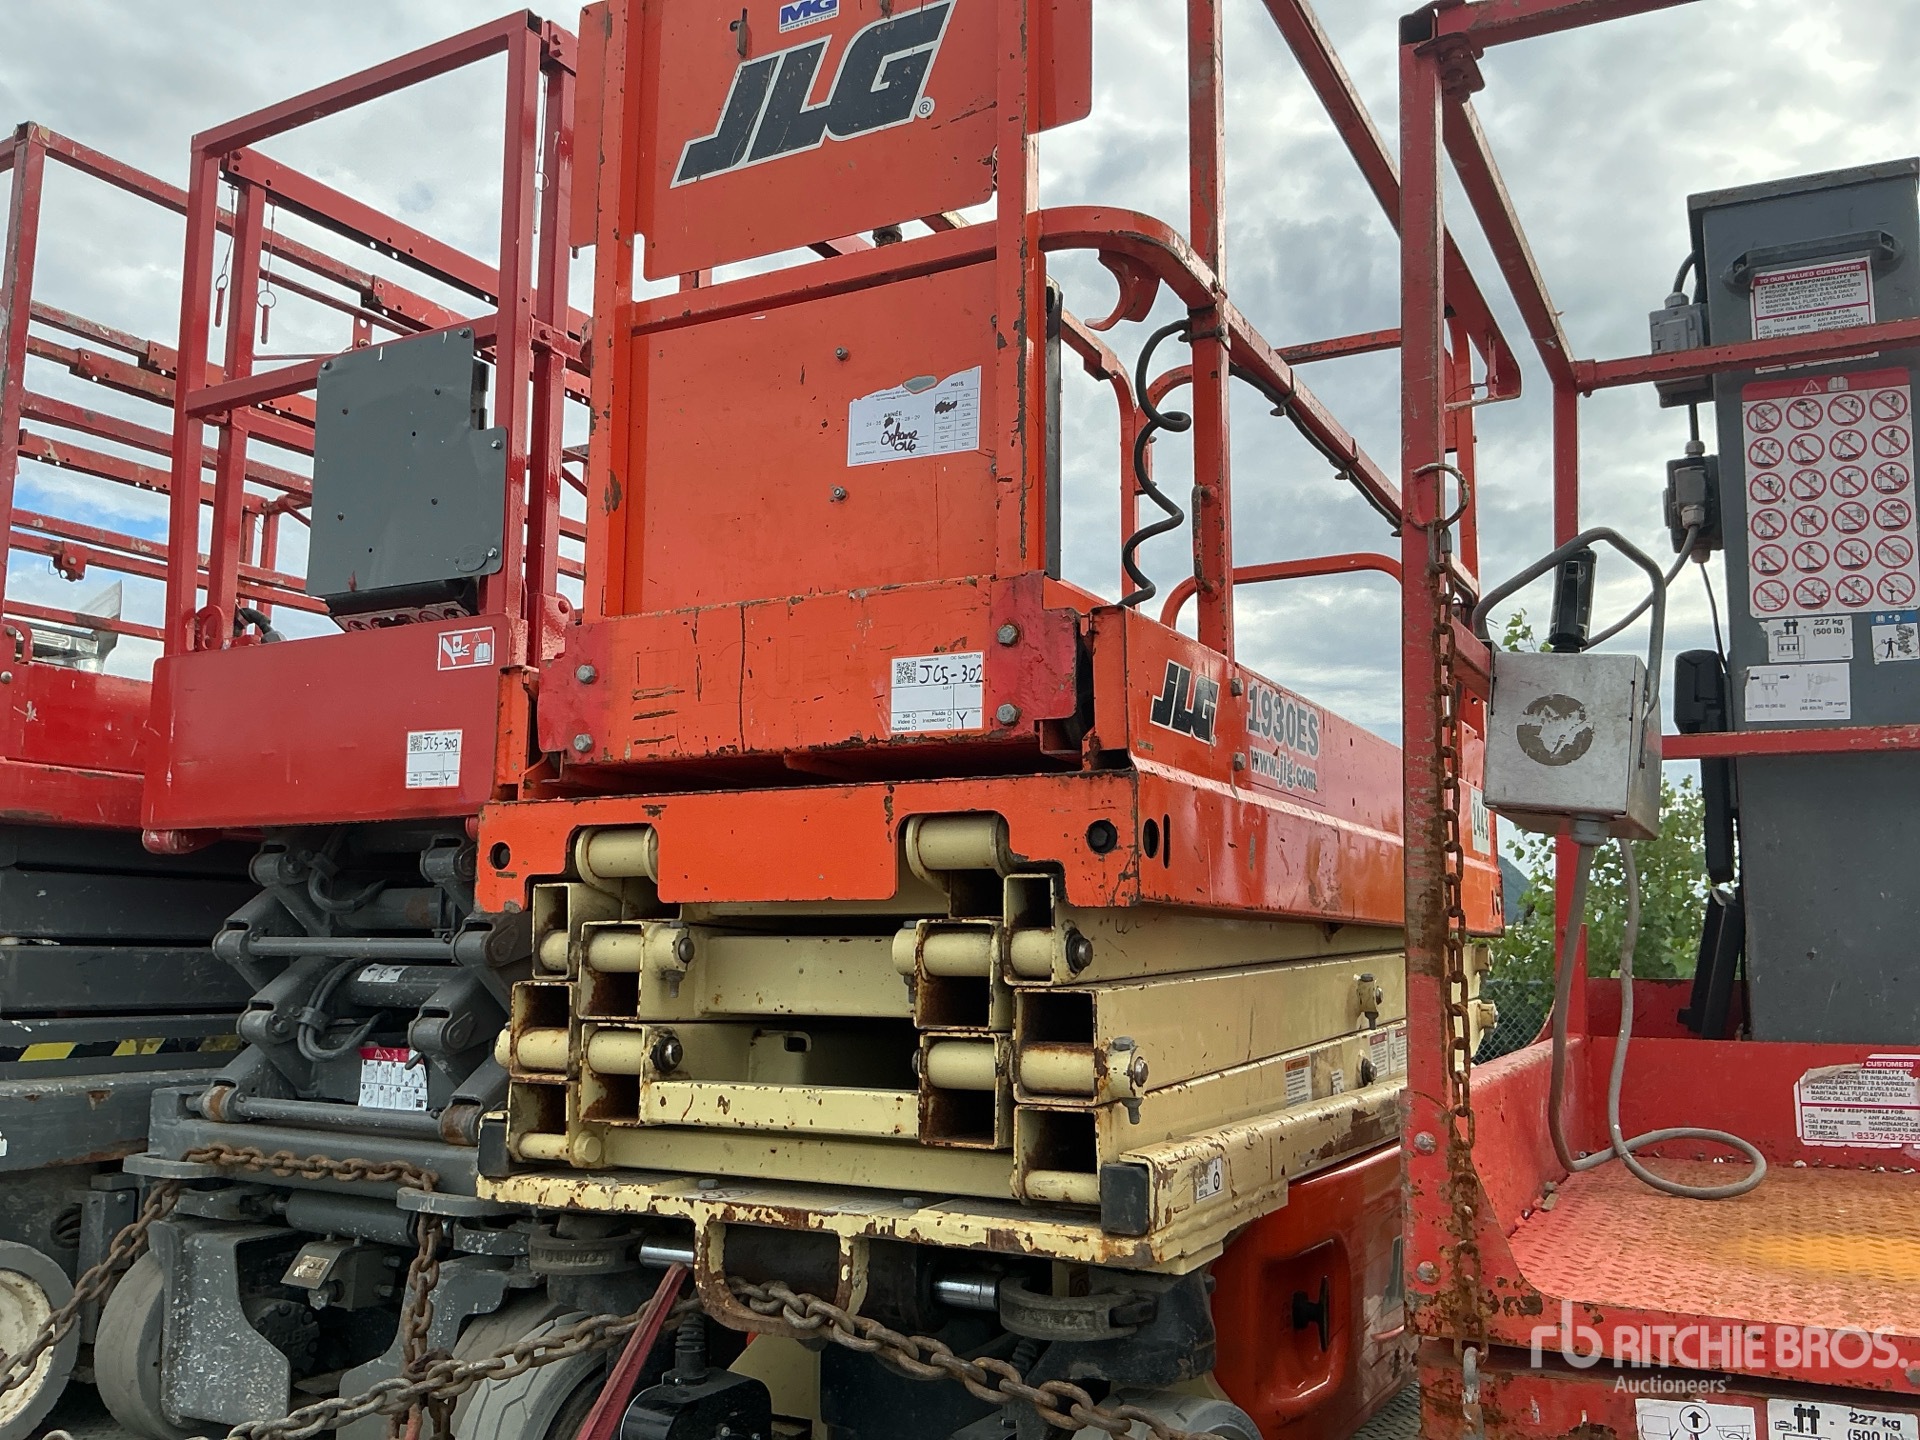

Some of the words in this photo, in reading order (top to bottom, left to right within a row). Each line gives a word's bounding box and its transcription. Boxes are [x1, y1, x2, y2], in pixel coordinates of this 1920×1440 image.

[670, 0, 955, 187] JLG
[1787, 271, 1815, 280] VALUED
[1816, 264, 1861, 275] CUSTOMERS
[1796, 274, 1847, 285] RESPONSIBILITY
[1820, 279, 1850, 287] INSURANCE
[1766, 301, 1790, 309] MAINTAIN
[1799, 310, 1836, 319] RESPONSIBLE
[1818, 318, 1854, 327] MAINTENANCE
[883, 410, 902, 418] ANNÉE
[1832, 618, 1843, 626] kg
[1813, 627, 1831, 637] (500
[1834, 627, 1845, 635] lb)
[1150, 659, 1220, 745] JLG
[1247, 680, 1319, 760] 1930ES
[1249, 747, 1318, 793] www.jlg.com
[1849, 1412, 1877, 1426] 227
[1882, 1417, 1901, 1431] kg
